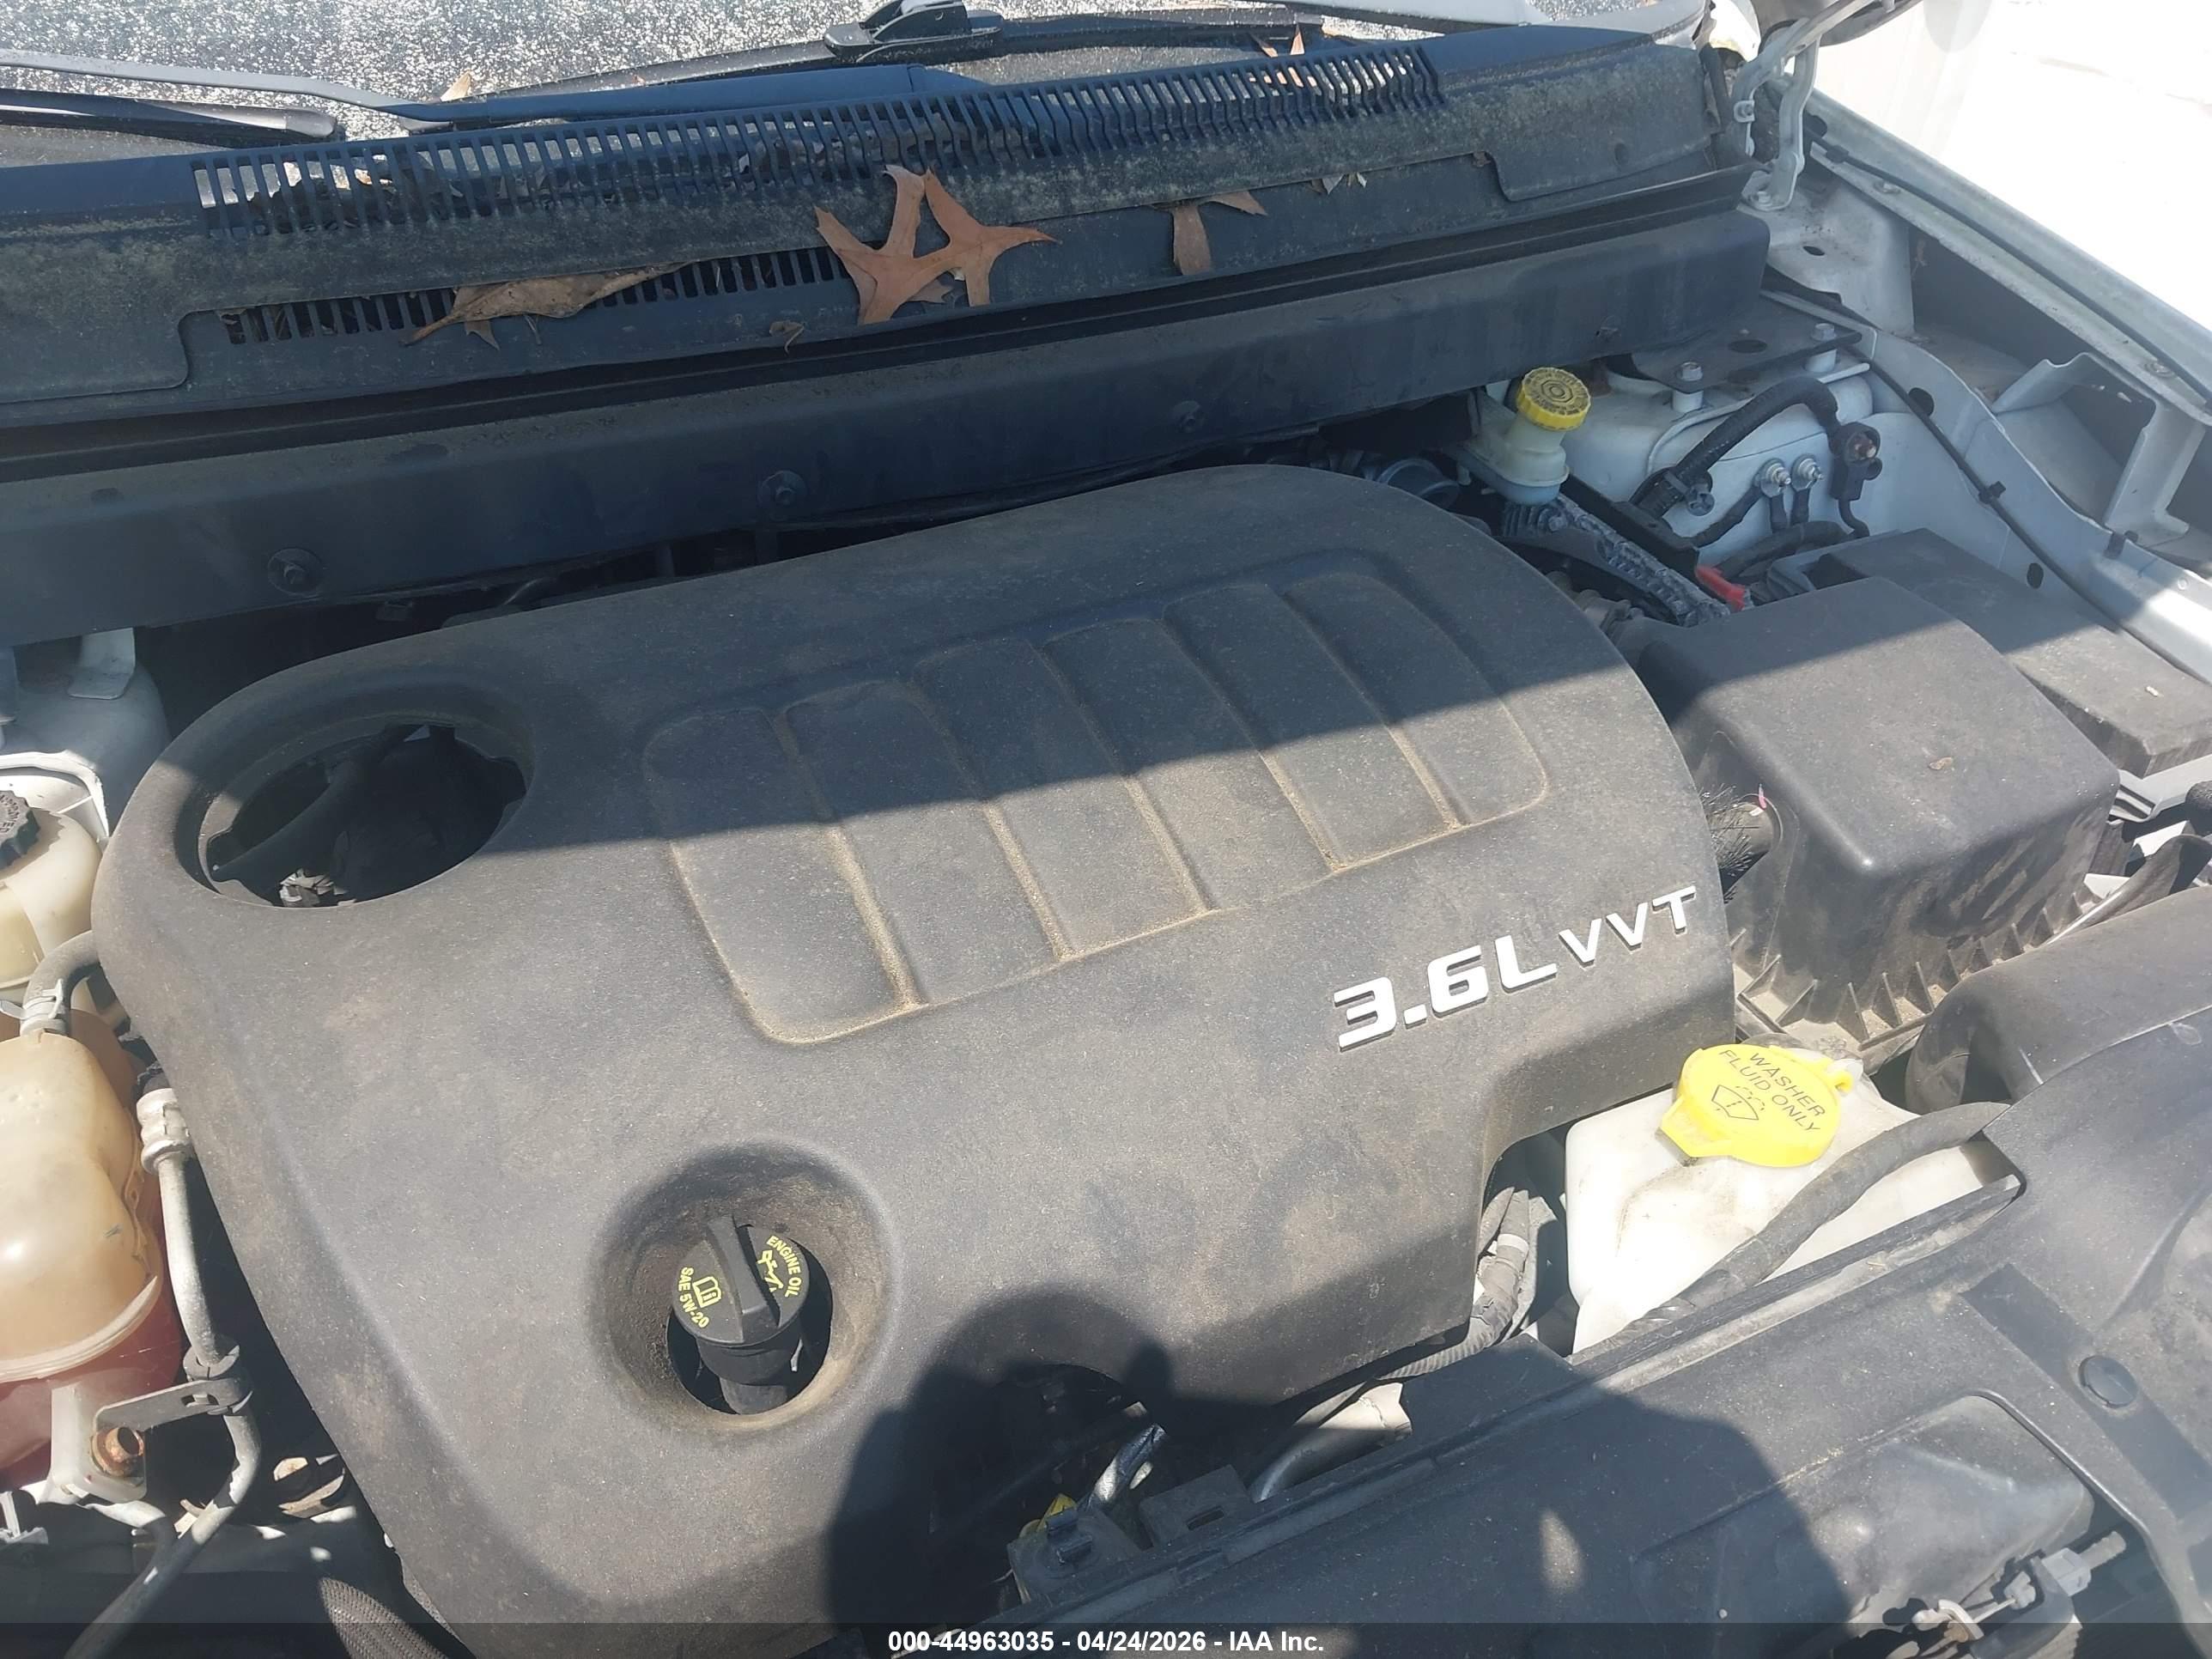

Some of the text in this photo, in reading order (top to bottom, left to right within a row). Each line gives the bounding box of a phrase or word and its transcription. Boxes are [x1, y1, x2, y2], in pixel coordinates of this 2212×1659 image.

[1334, 885, 1697, 1052] 3.6L VVT
[1719, 1049, 1821, 1132] FLUID ONLY
[1750, 1053, 1826, 1117] WASHER
[678, 1267, 710, 1328] SAE 5W-20
[767, 1236, 803, 1297] ENGINE OIL
